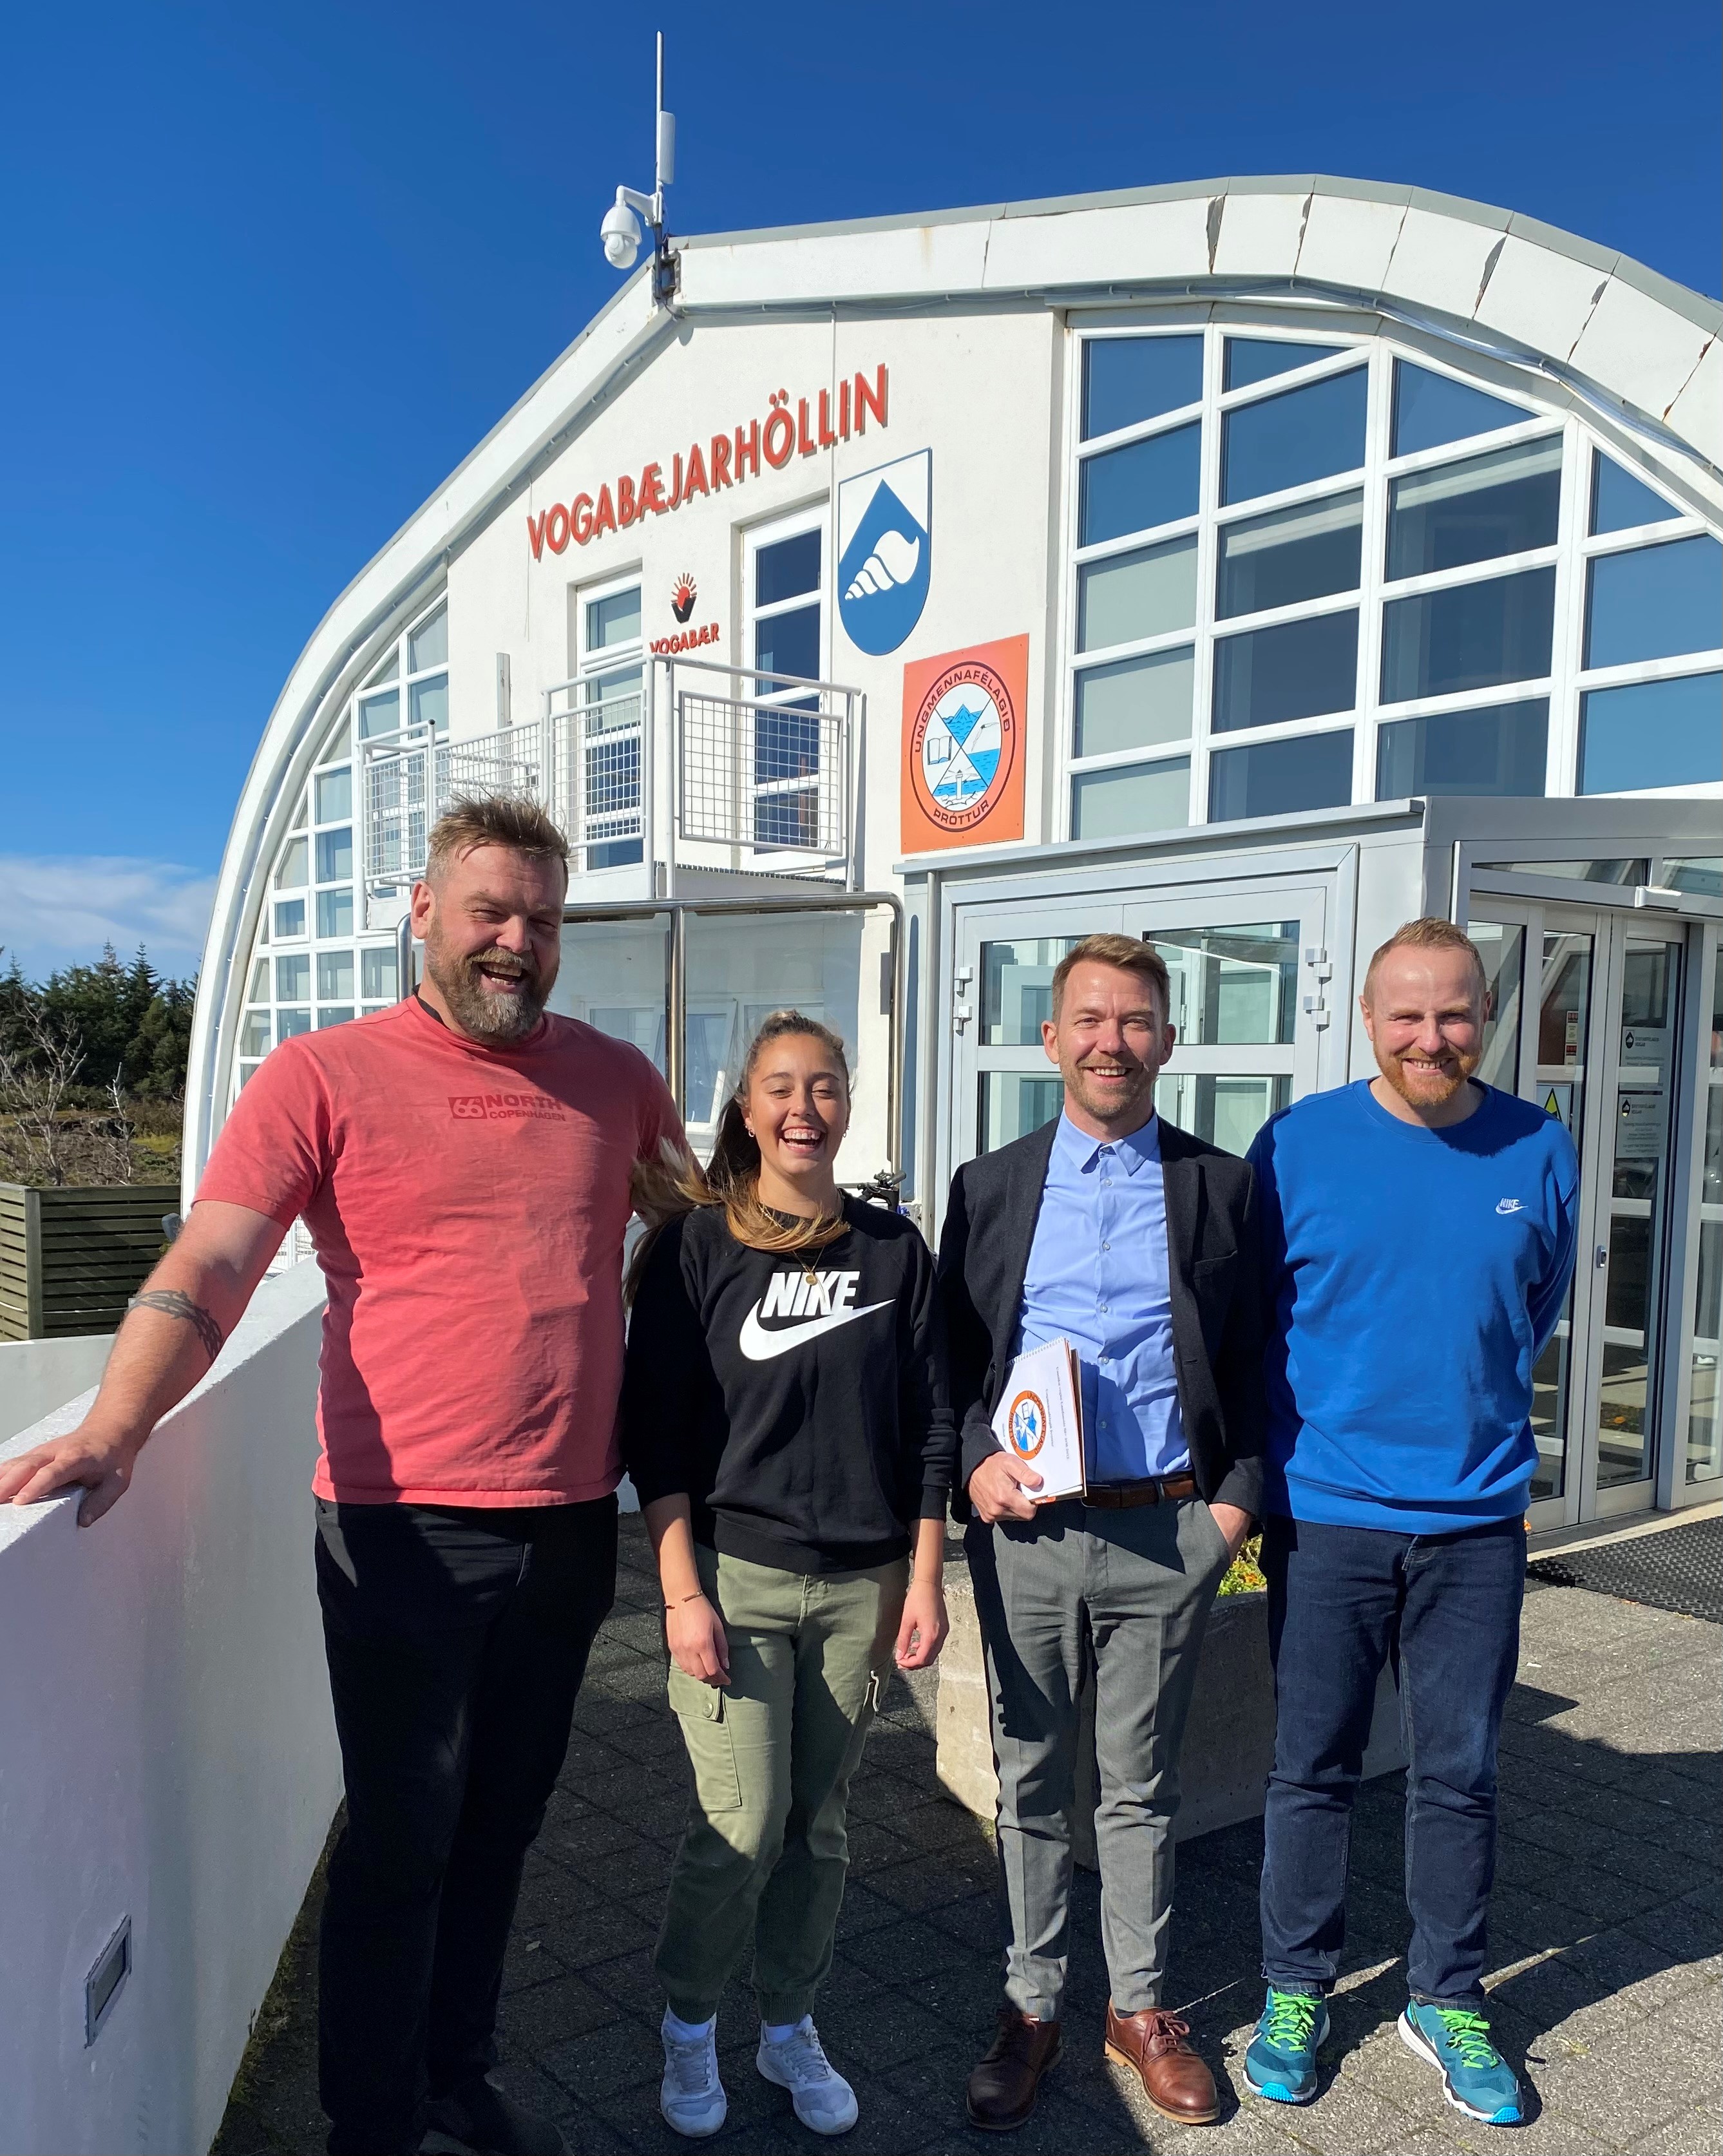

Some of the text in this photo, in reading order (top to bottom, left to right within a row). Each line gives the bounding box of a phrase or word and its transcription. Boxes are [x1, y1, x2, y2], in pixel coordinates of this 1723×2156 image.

[526, 363, 888, 560] VOGABÆJARHÖLLIN
[649, 622, 719, 654] VOGABÆR
[915, 669, 1011, 753] UNGMENNAFÉLAGIÐ
[933, 799, 990, 826] ÞRÓTTUR
[487, 1094, 562, 1111] NORTH
[489, 1109, 566, 1121] COPENHAGEN
[1499, 1197, 1519, 1209] NIKE
[760, 1271, 860, 1318] NIKE
